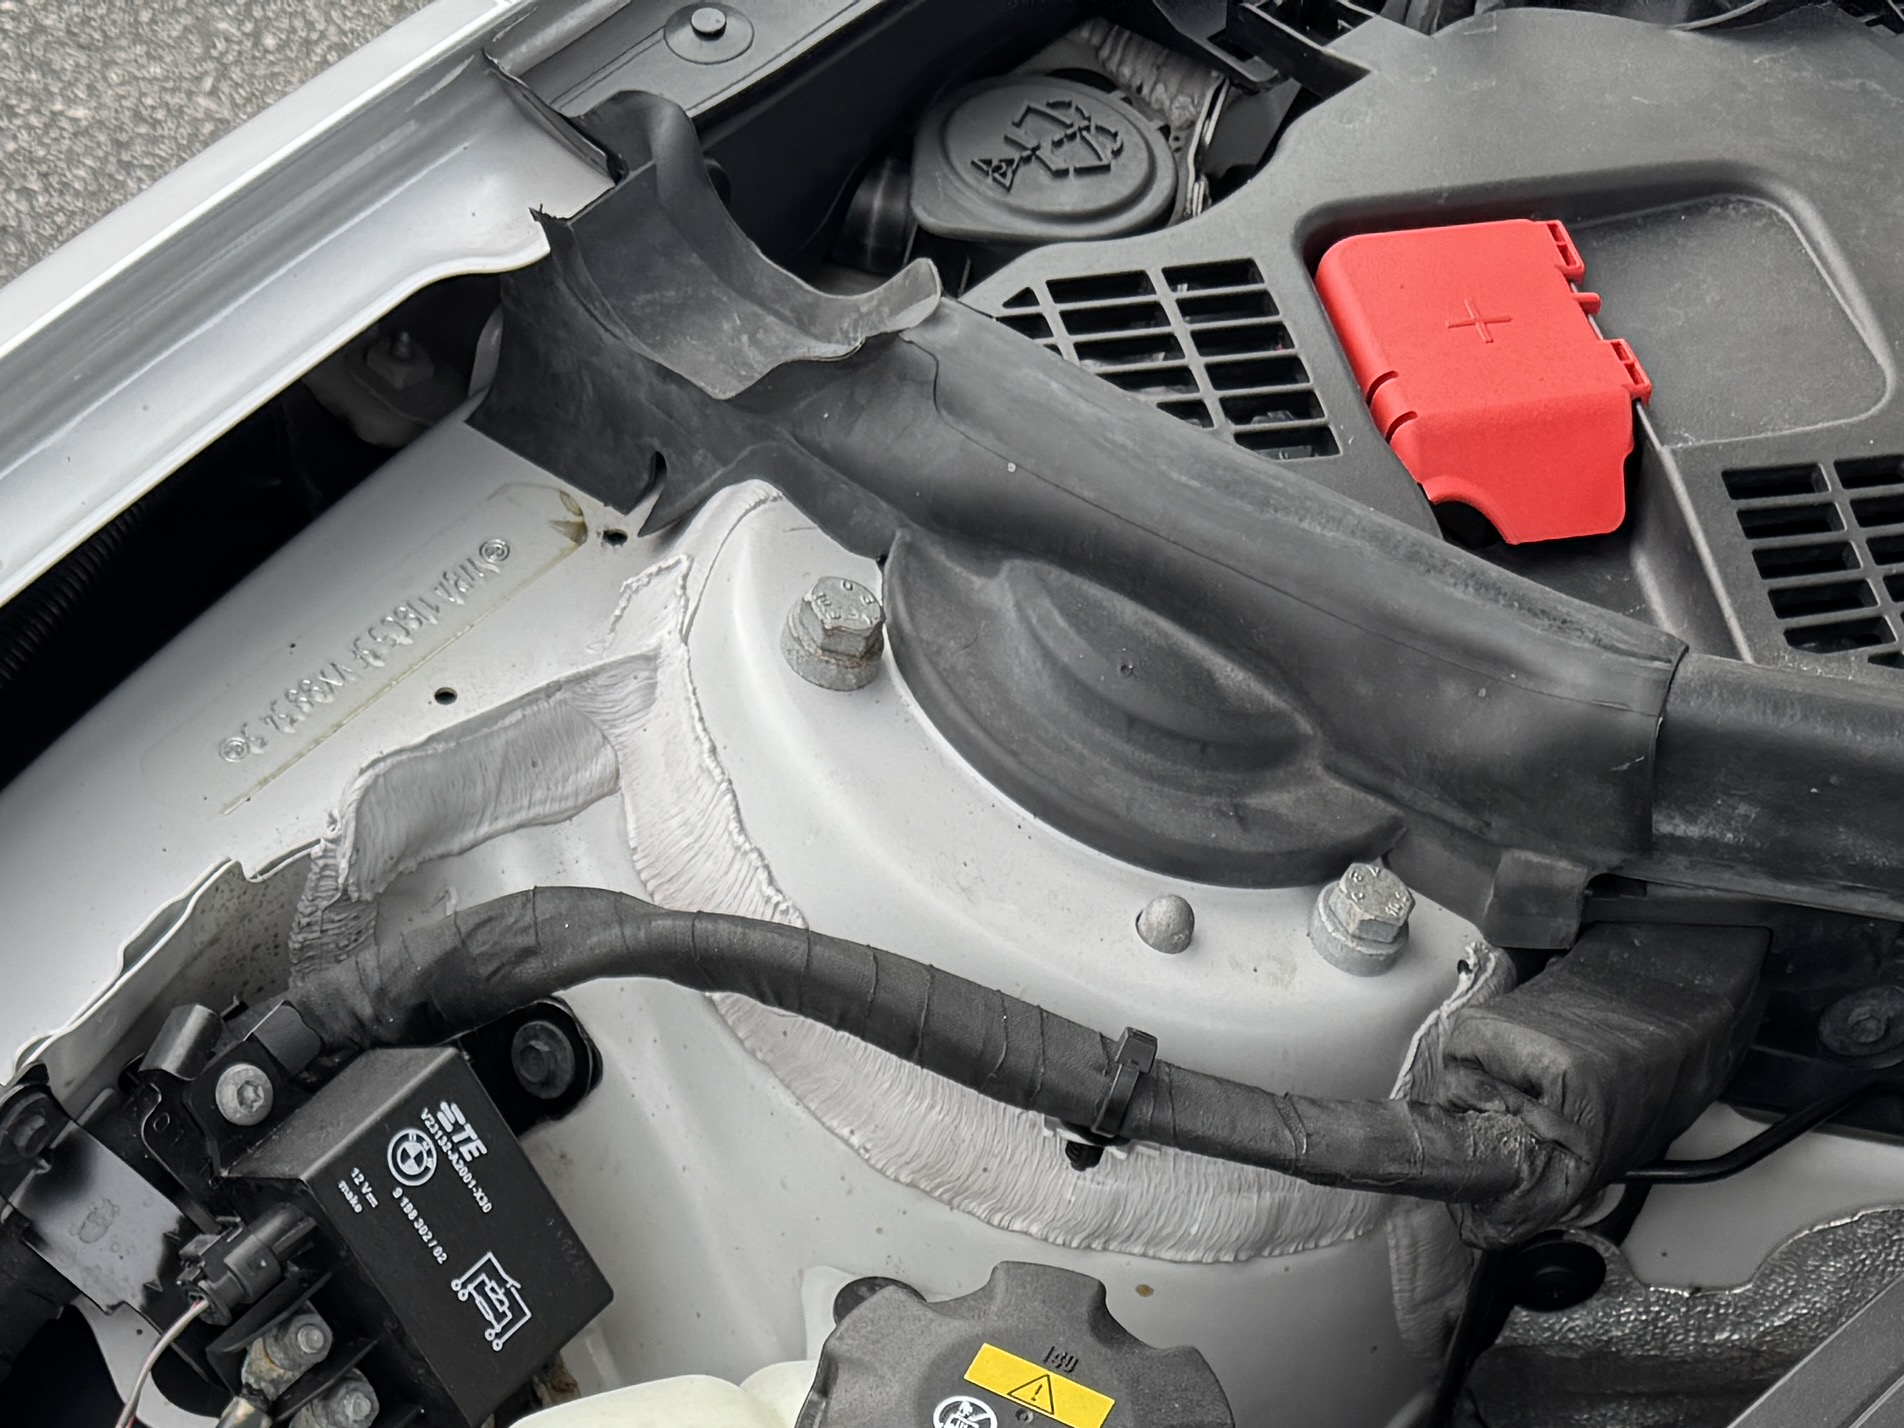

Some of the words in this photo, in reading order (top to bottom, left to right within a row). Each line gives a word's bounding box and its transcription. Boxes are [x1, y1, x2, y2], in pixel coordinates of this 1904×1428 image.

[350, 1166, 365, 1187] 12
[336, 1178, 364, 1214] make
[390, 1186, 403, 1199] 9
